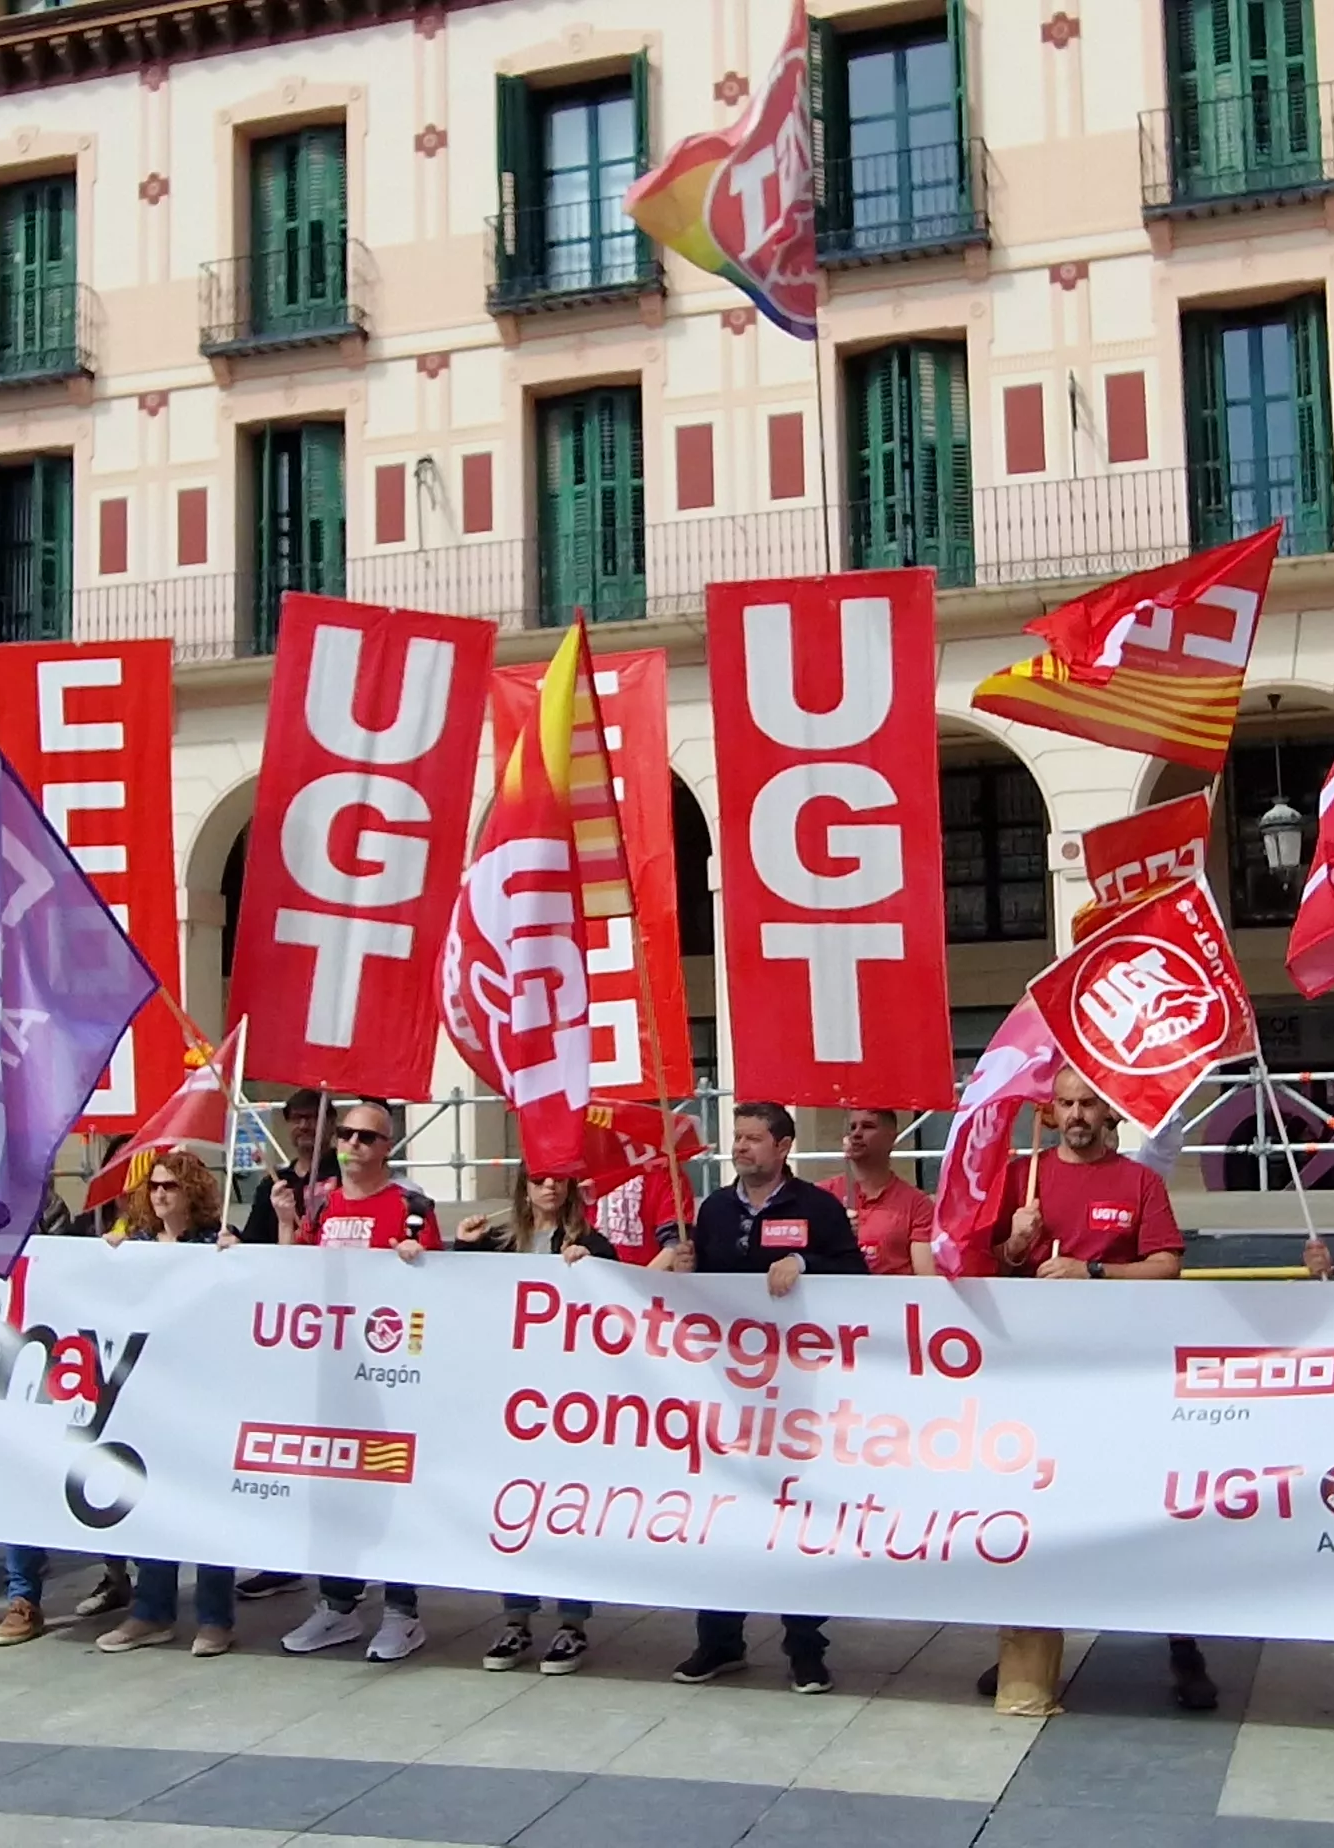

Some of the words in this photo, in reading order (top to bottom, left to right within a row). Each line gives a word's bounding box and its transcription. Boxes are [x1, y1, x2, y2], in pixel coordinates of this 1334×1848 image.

[273, 624, 455, 1049] UGT
[741, 598, 904, 1063] UGT
[1078, 947, 1168, 1043] UGT
[321, 1216, 376, 1239] SOMOS
[1092, 1207, 1119, 1221] UGT
[252, 1301, 356, 1351] UGT
[512, 1280, 869, 1388] Proteger
[905, 1302, 984, 1379] lo
[354, 1362, 421, 1388] Aragón
[1185, 1356, 1334, 1389] CCOO
[503, 1385, 1057, 1490] conquistado,
[1170, 1405, 1251, 1426] Aragón
[242, 1431, 360, 1470] CCOO
[230, 1478, 291, 1500] Aragón
[1164, 1465, 1304, 1520] UGT
[489, 1478, 737, 1554] ganar
[766, 1474, 1032, 1565] futuro
